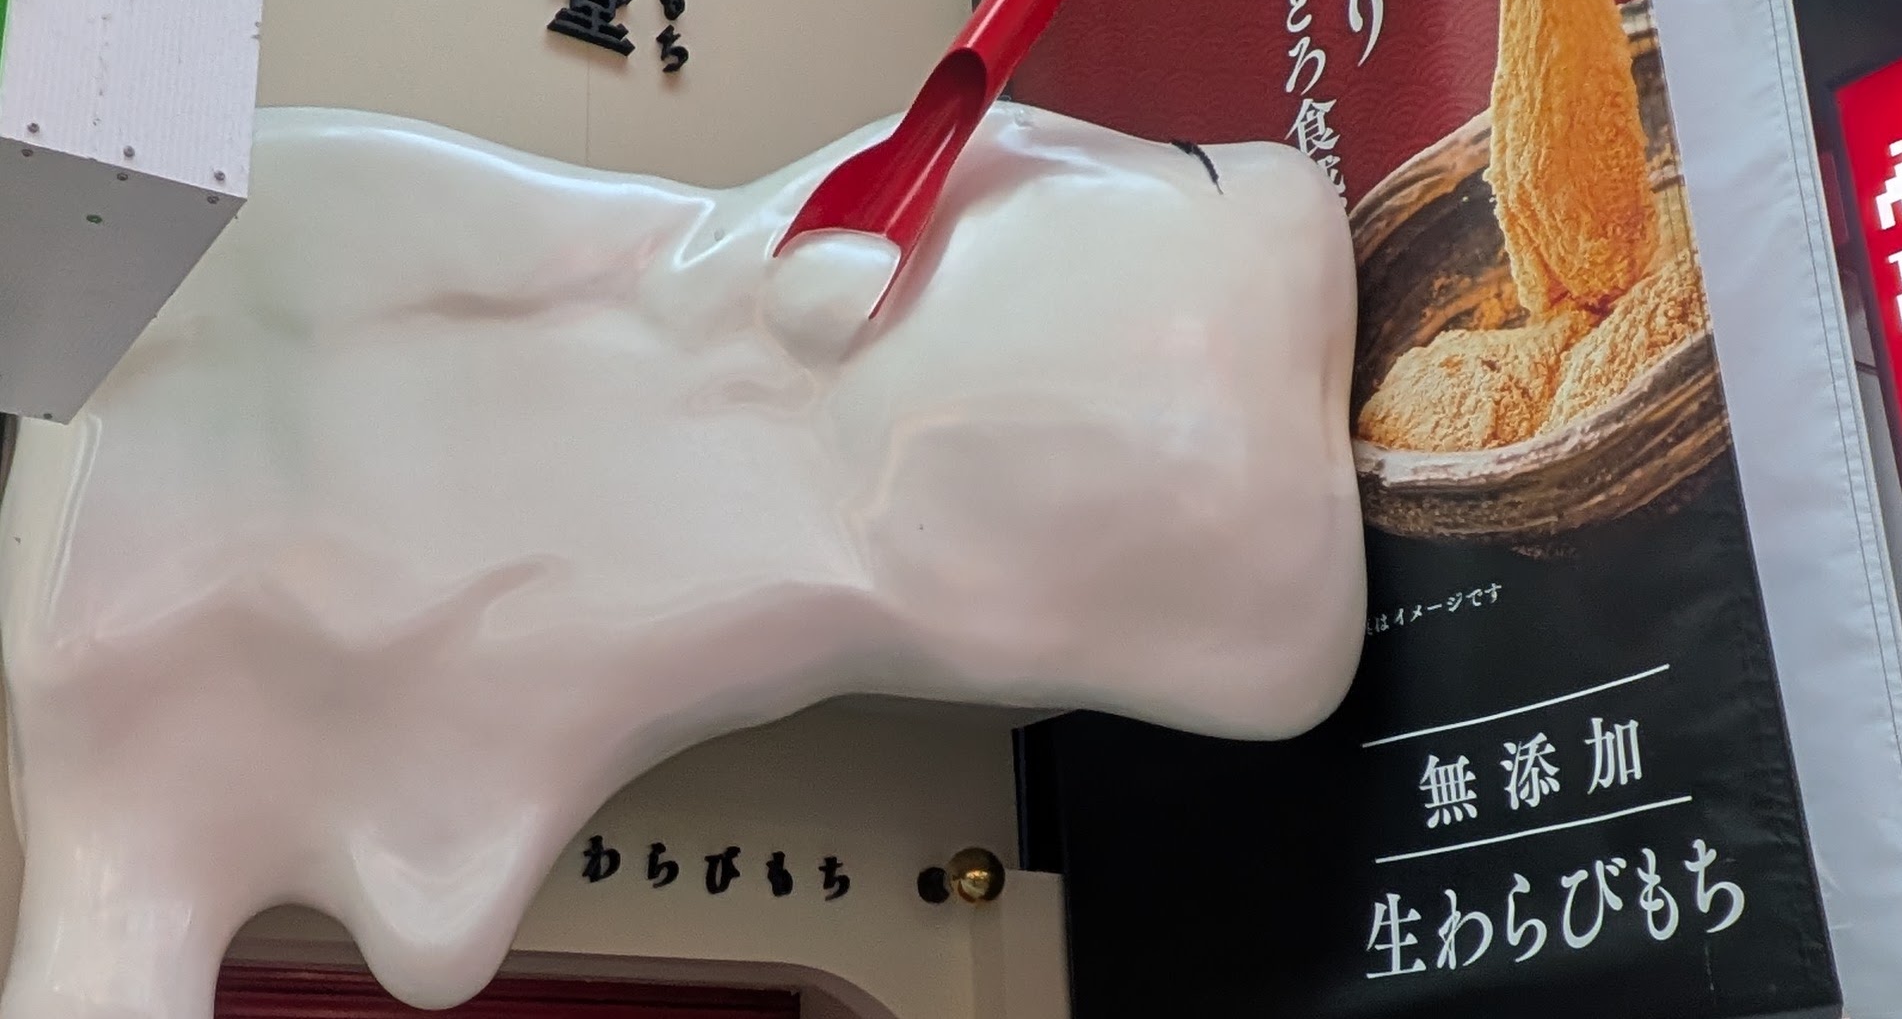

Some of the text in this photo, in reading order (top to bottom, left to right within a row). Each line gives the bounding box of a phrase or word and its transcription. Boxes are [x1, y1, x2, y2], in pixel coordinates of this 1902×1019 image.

[1418, 717, 1643, 829] 無添加
[582, 834, 851, 902] わらびもち
[1366, 839, 1746, 979] 生わらびもち
